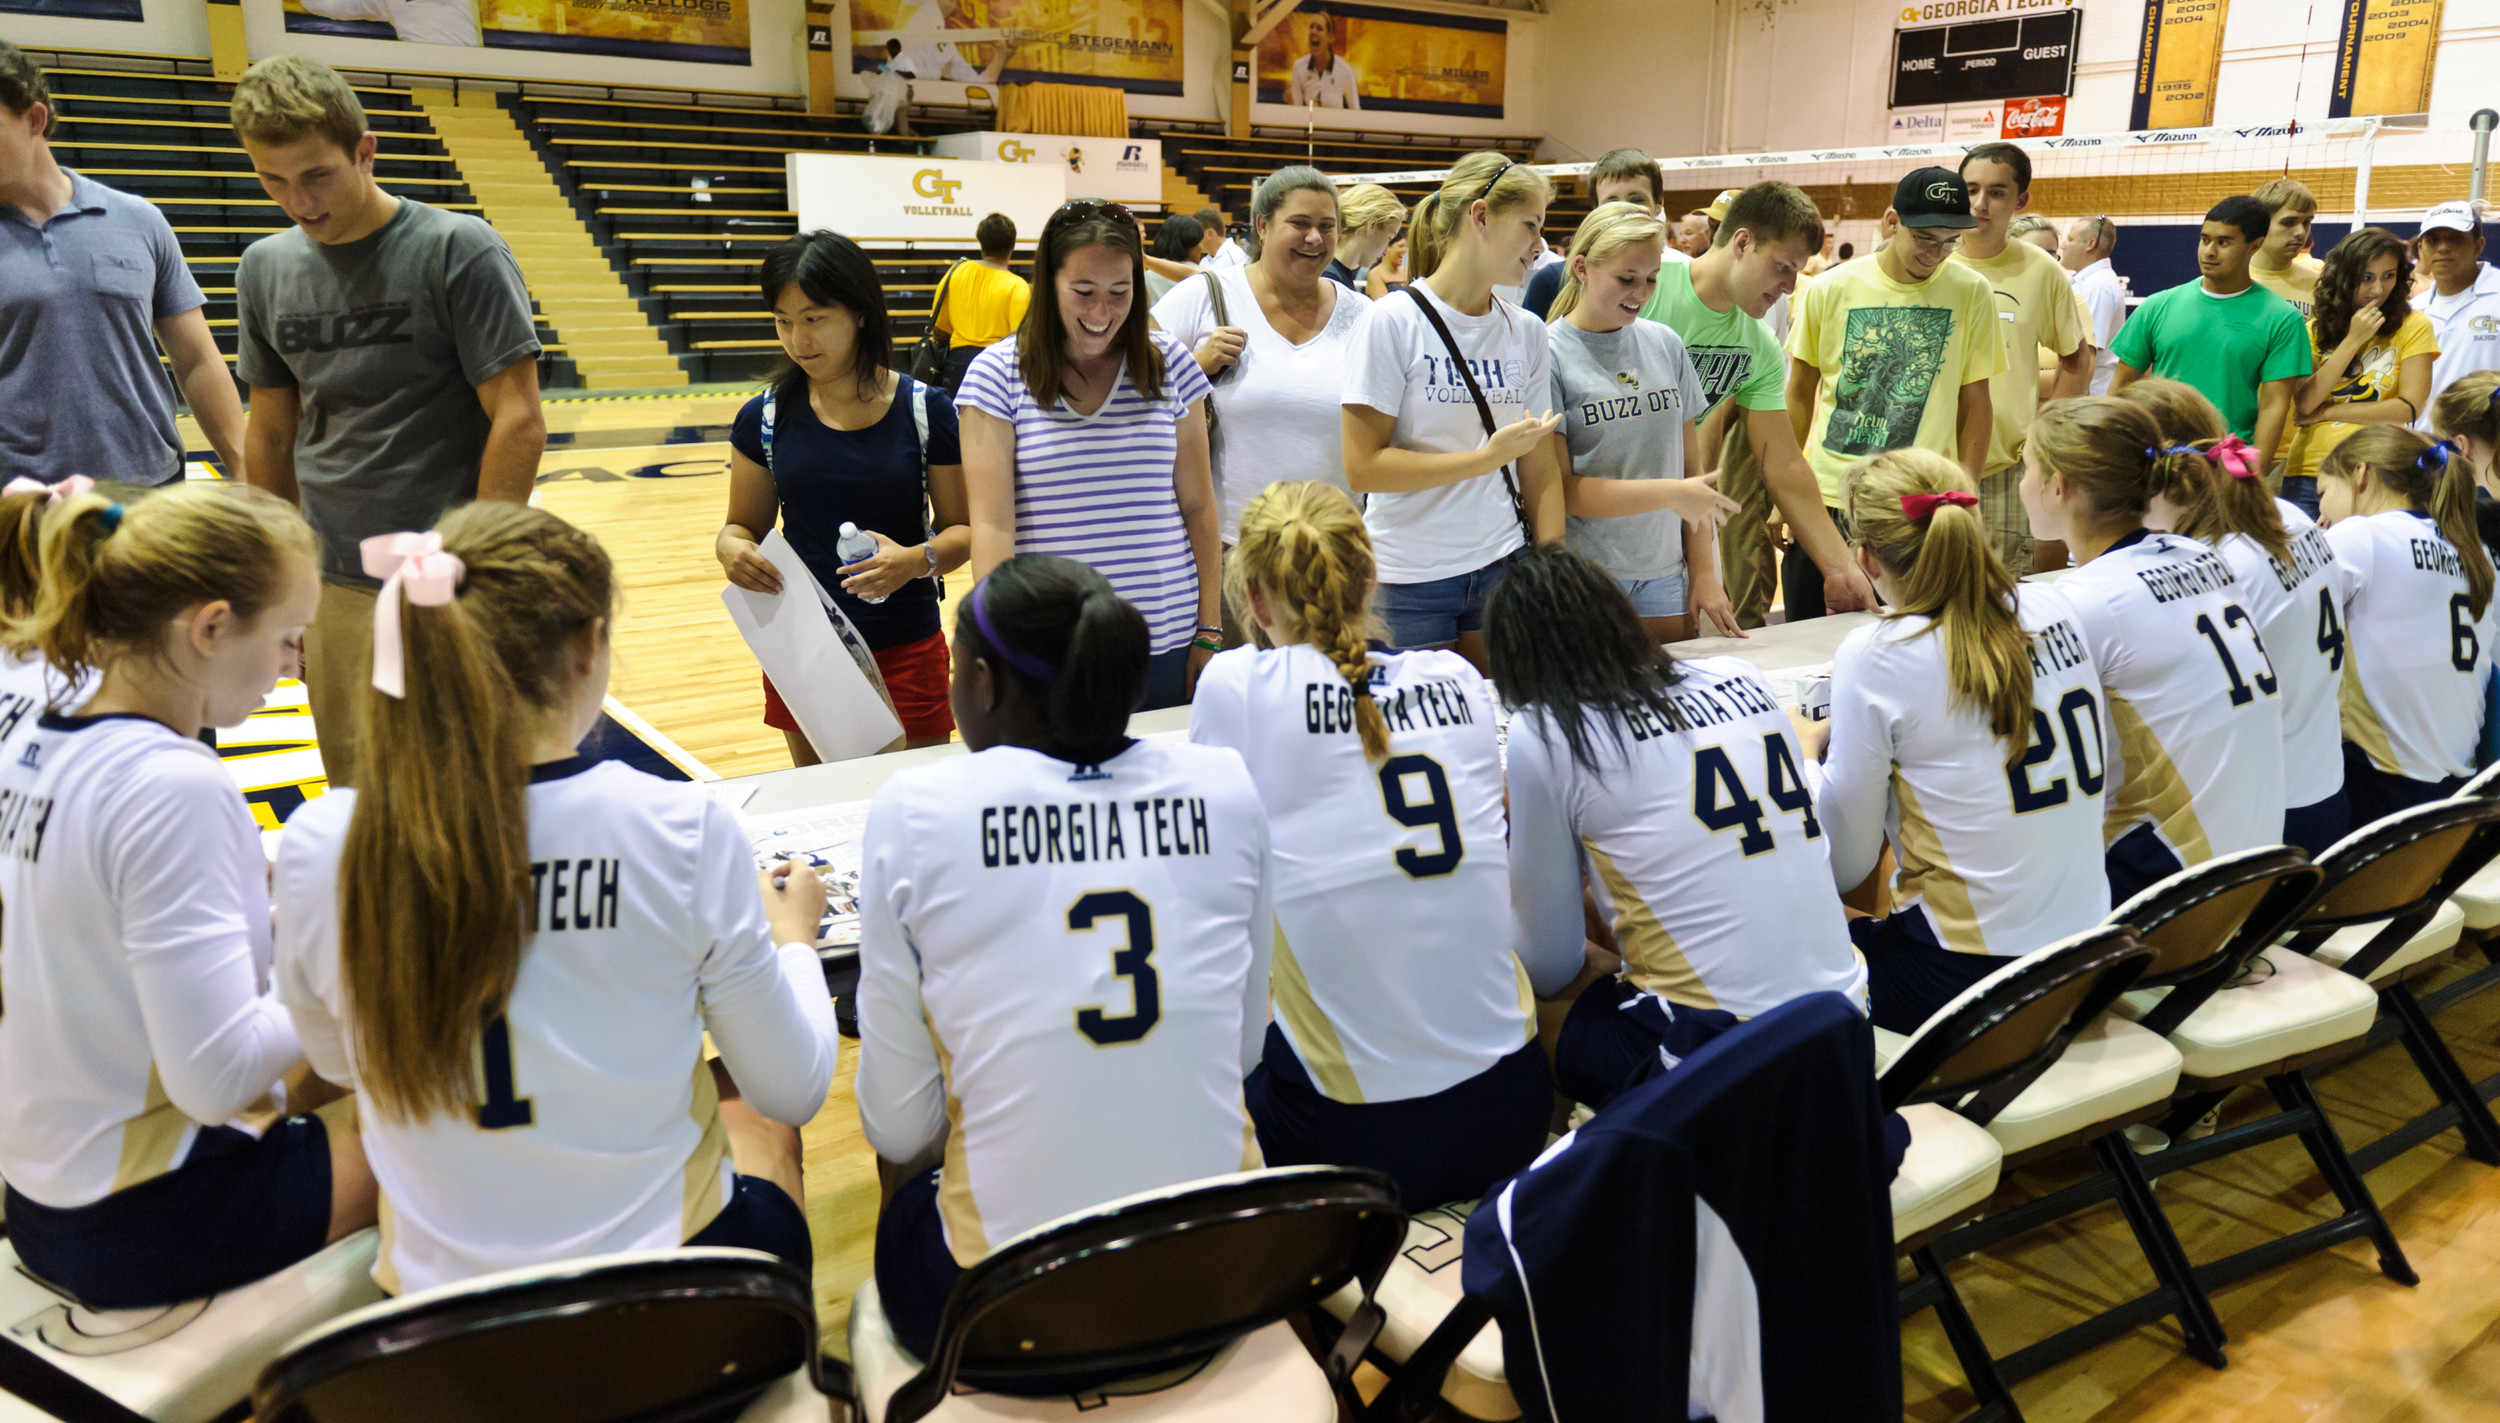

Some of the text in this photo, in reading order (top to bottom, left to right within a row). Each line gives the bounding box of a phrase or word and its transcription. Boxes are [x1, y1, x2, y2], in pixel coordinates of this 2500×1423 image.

[1923, 0, 1999, 20] GEORGIA
[2165, 15, 2203, 25] 2004
[2177, 4, 2216, 13] 2003
[2368, 10, 2410, 20] 2003
[2388, 20, 2428, 29] 2004
[1068, 34, 1174, 53] STEGEMANN
[2023, 45, 2067, 61] GUEST
[2138, 5, 2157, 94] CHAMPIONS
[2338, 0, 2360, 99] OURNAMENT
[2365, 32, 2406, 42] 2009
[1901, 58, 1935, 72] HOME
[1965, 57, 1997, 69] PERIOD
[2156, 83, 2192, 92] 1995
[1907, 116, 1942, 129] Delta
[2255, 126, 2304, 137] MIZUO
[913, 169, 962, 204] GT
[903, 205, 973, 217] VOLLEYBALL
[276, 305, 414, 354] BUZZ
[1582, 387, 1681, 427] BUZZ OFF
[2317, 584, 2345, 673] 4
[2449, 592, 2480, 673] 6
[2195, 603, 2279, 708] 13
[1306, 680, 1474, 735] GEOIA TECH
[1713, 675, 1779, 718] TECH
[1991, 686, 2106, 816] 20
[1691, 728, 1822, 860] 44
[981, 797, 1211, 868] GEORGIA TECH
[1376, 753, 1466, 881] 9
[530, 857, 620, 933] TECH
[1066, 887, 1163, 1049] 3
